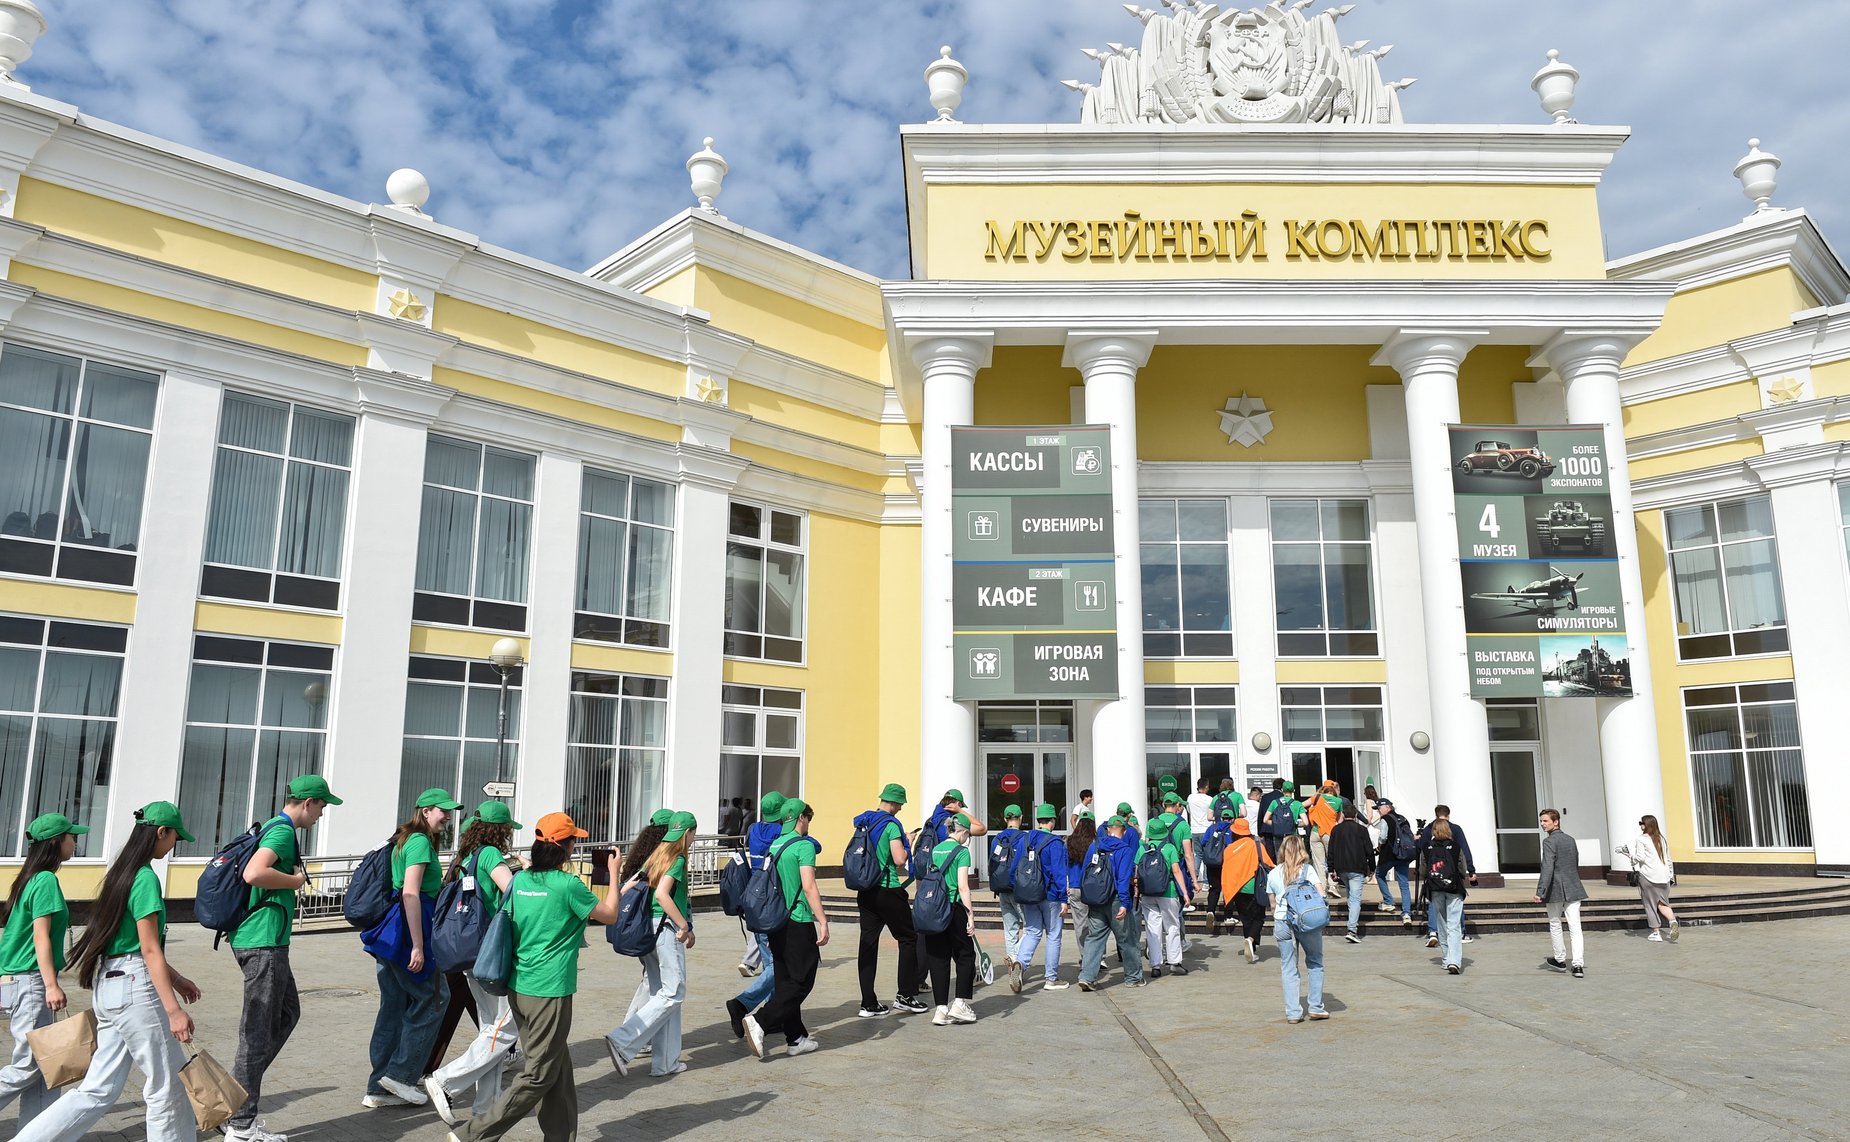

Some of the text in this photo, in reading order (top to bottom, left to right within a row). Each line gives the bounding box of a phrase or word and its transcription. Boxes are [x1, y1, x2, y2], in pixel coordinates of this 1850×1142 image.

[984, 209, 1552, 261] МУЗЕЙНЫЙ КОМПЛЕКС
[1033, 437, 1060, 445] 1 ЭТАЖ
[1572, 445, 1600, 454] БОЛЕЕ
[970, 452, 1044, 472] КАССЫ
[1559, 457, 1602, 476] 1000
[1550, 478, 1603, 487] ЭКСПОНАТОВ
[1022, 517, 1104, 533] СУВЕНИРЫ
[1478, 504, 1500, 538] 4
[1473, 544, 1517, 557] МУЗЕЯ
[1035, 570, 1063, 578] 2 ЭТАЖ
[977, 586, 1038, 607] КАФЕ
[1580, 606, 1617, 615] ИГРОВЫЕ
[1537, 617, 1618, 630] СИМУЛЯТОРЫ
[1034, 645, 1103, 660] ИГРОВАЯ
[1475, 650, 1535, 662] ВЫСТАВКА
[1048, 666, 1090, 681] ЗОНА
[1476, 667, 1535, 676] ПОД ОТКРЫТЫМ
[1476, 677, 1502, 685] НЕБОМ
